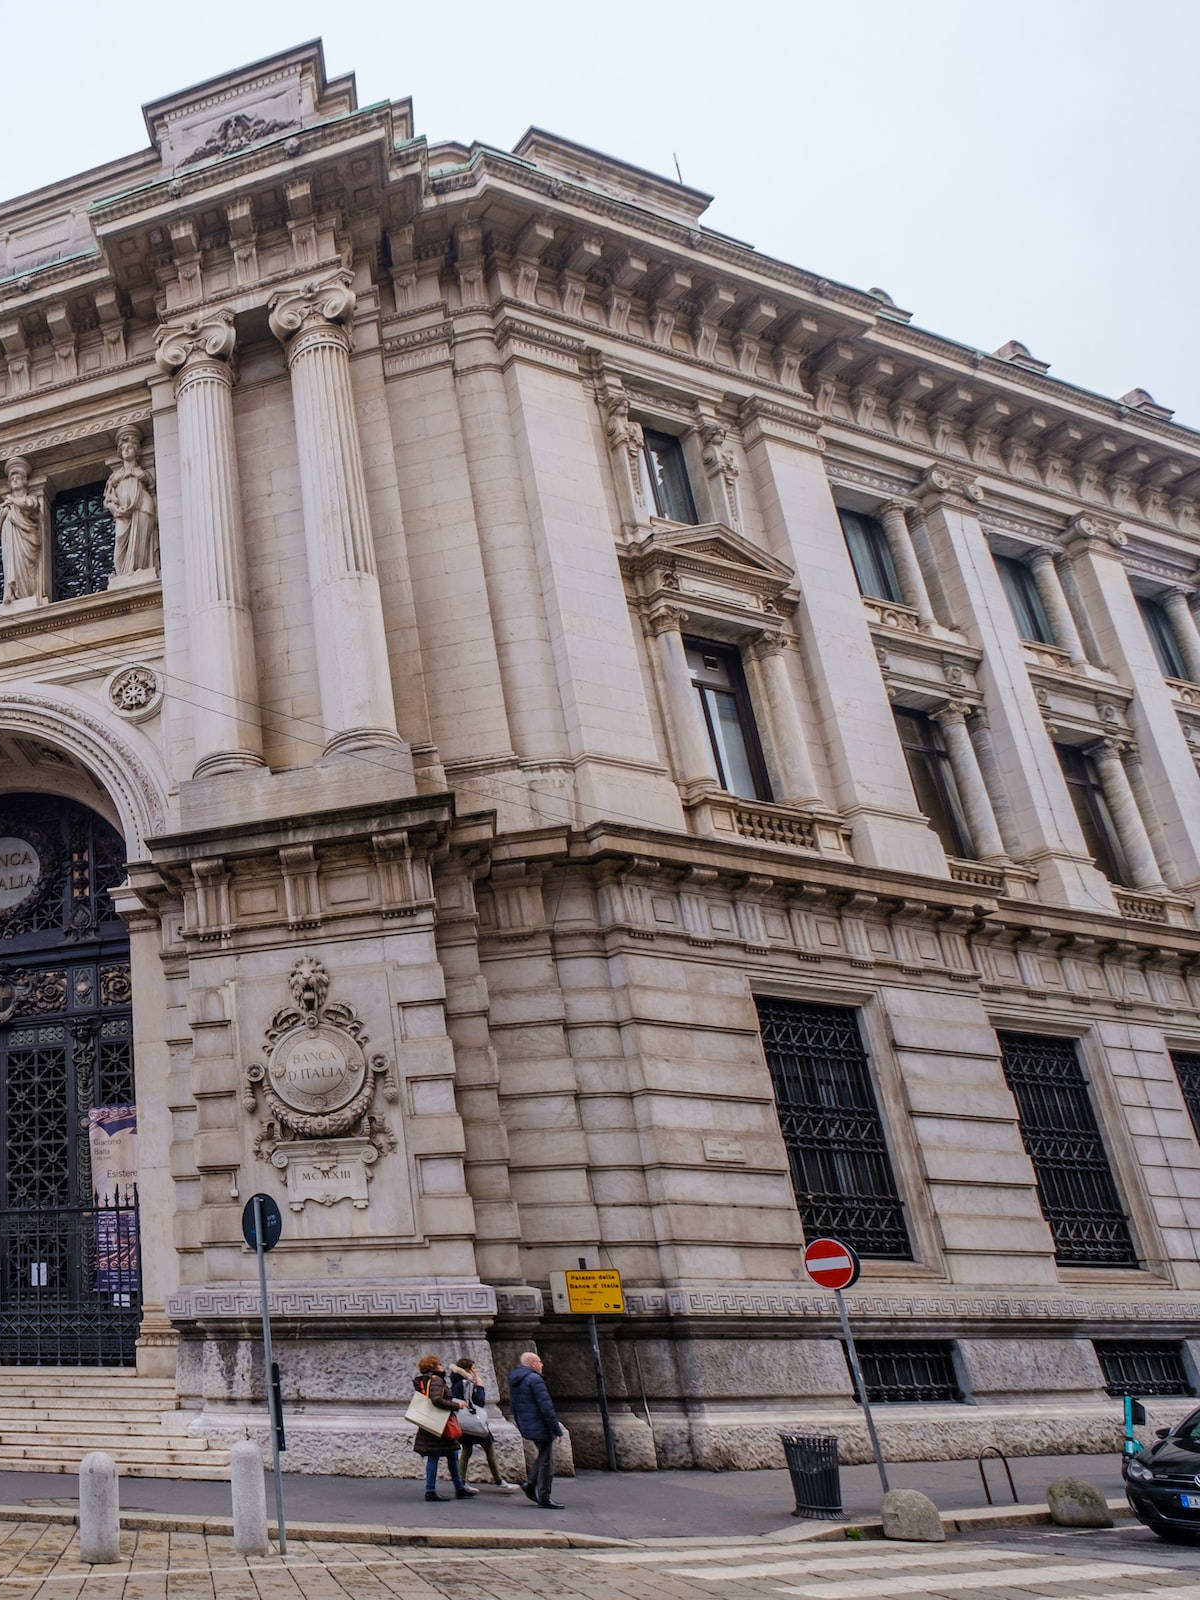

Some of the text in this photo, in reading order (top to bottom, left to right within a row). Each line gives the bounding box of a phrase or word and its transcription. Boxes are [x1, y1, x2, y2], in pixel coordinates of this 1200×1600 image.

[293, 1051, 337, 1064] BANCA
[93, 1138, 121, 1146] Giacomo
[107, 1169, 138, 1178] Esistere
[302, 1169, 352, 1181] MCMXIII
